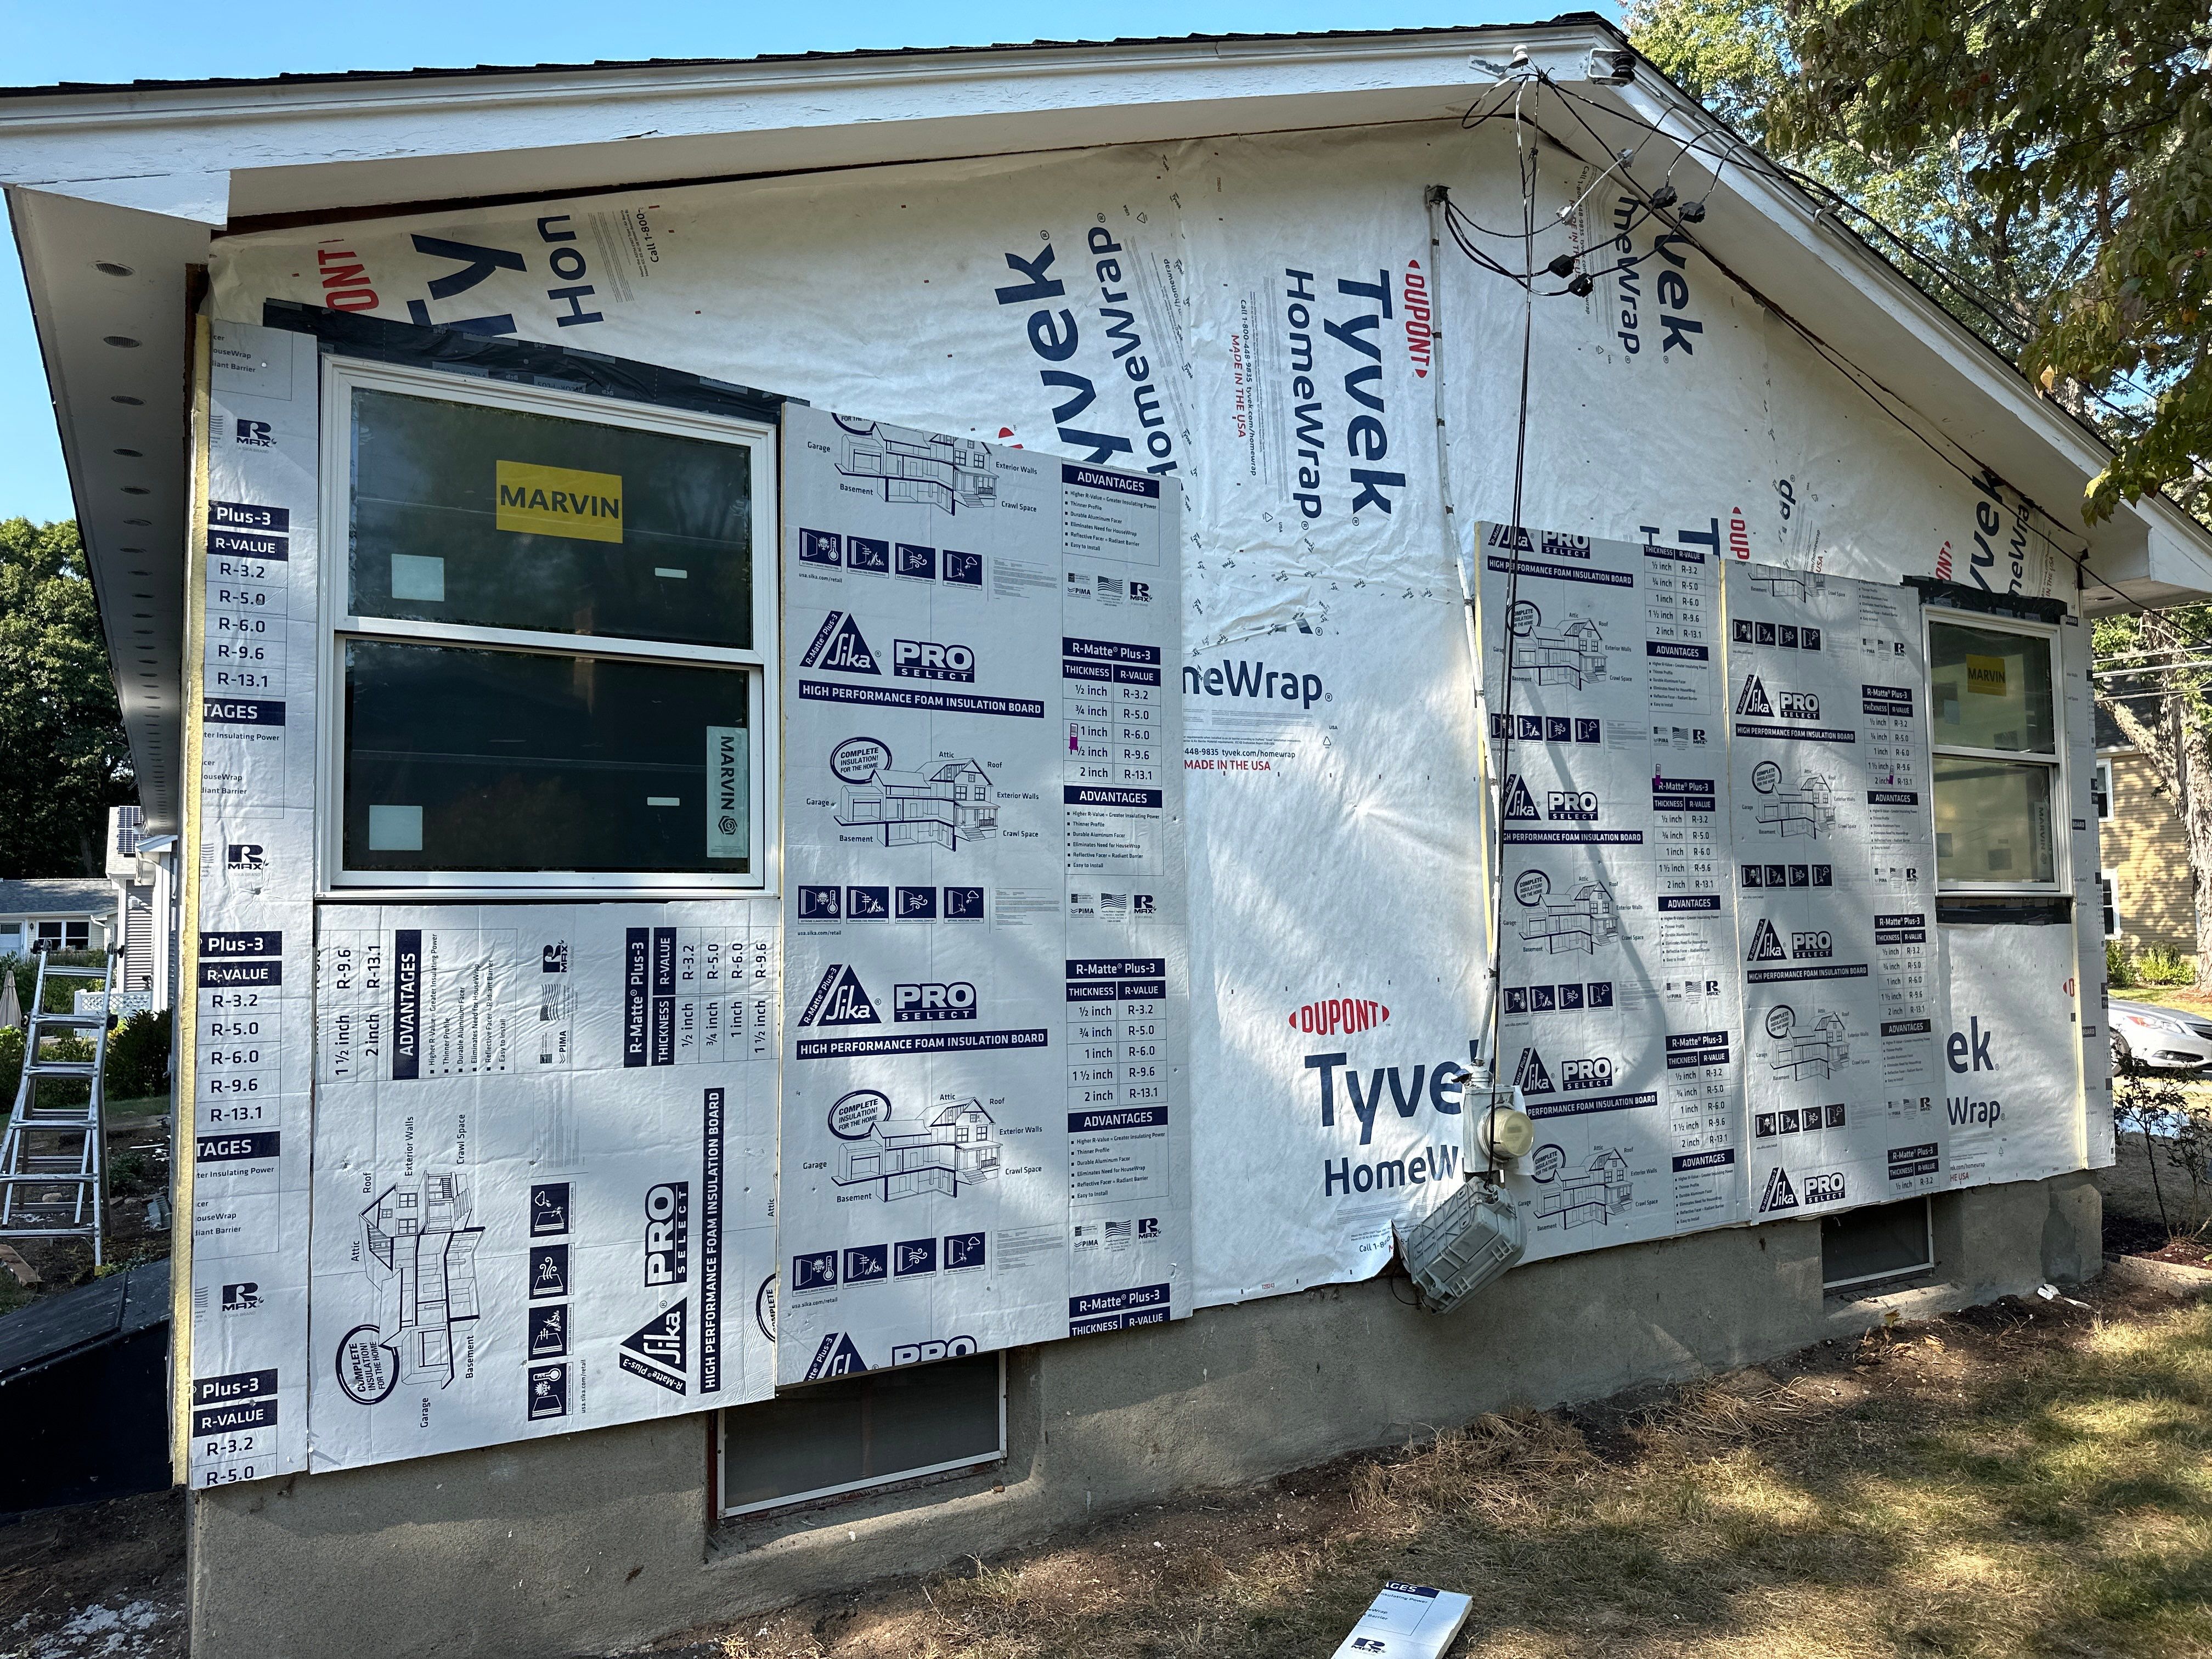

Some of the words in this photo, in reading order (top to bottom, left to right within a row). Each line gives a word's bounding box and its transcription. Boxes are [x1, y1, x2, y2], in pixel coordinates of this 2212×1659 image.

[636, 207, 652, 241] 1-800-
[647, 242, 659, 263] Call
[1404, 273, 1431, 371] DUPONT
[1231, 335, 1242, 370] MADE
[1242, 318, 1252, 382] 1-800-448-9835
[1235, 373, 1243, 385] IN
[1236, 388, 1244, 411] THE
[1237, 415, 1246, 438] USA
[1246, 387, 1256, 476] tyvek.com/homewrap
[808, 442, 831, 453] Garage
[996, 462, 1018, 473] Exterior
[1021, 465, 1037, 475] Walls
[840, 484, 873, 495] Basement
[1077, 472, 1144, 492] ADVANTAGES
[500, 484, 619, 520] MARVIN
[1001, 501, 1017, 510] Crawl
[1020, 504, 1037, 513] Space
[217, 506, 271, 527] Plus-3
[215, 537, 275, 554] R-VALUE
[220, 562, 264, 579] R-3.2
[220, 589, 265, 605] R-5.0
[219, 617, 266, 633] R-6.0
[218, 644, 264, 660] R-9.6
[896, 642, 973, 669] PRO
[1121, 648, 1150, 660] Plus-3
[217, 672, 268, 688] R-13.1
[901, 669, 967, 681] SELECT
[1065, 665, 1109, 677] THICKNESS
[1120, 670, 1153, 681] R-VALUE
[1968, 667, 2005, 683] MARVIN
[803, 685, 829, 697] HIGH
[832, 688, 911, 703] PERFORMANCE
[915, 694, 943, 706] FOAM
[946, 697, 1005, 710] INSULATION
[1008, 702, 1041, 713] BOARD
[1892, 691, 1906, 699] Plus-3
[1737, 727, 1750, 735] HIGH
[1752, 727, 1790, 736] PERFORMANCE
[1791, 729, 1805, 737] FOAM
[1806, 730, 1836, 739] INSULATION
[1222, 748, 1295, 759] tyvek.com/homewrap
[720, 736, 736, 810] MARVIN
[1184, 760, 1215, 770] MADE
[1217, 760, 1227, 770] IN
[1229, 760, 1249, 770] THE
[1251, 760, 1271, 771] USA
[1689, 783, 1708, 792] Plus-3
[1549, 793, 1596, 811] PRO
[1673, 881, 1685, 889] inch
[1668, 899, 1711, 909] ADVANTAGES
[208, 937, 263, 951] Plus-3
[337, 949, 351, 989] R-9.6
[367, 945, 381, 988] R-13.1
[631, 942, 644, 985] Plus-3
[660, 937, 670, 985] R-VALUE
[682, 945, 695, 980] R-3.2
[732, 943, 743, 979] R-6.0
[207, 968, 268, 981] R-VALUE
[399, 952, 415, 1057] ADVANTAGES
[731, 1001, 742, 1028] inch
[681, 1002, 693, 1030] inch
[1301, 998, 1378, 1035] DUPONT
[335, 1015, 349, 1045] inch
[366, 1014, 380, 1045] inch
[658, 1001, 669, 1063] THICKNESS
[681, 1034, 693, 1047] ½
[365, 1048, 376, 1056] 2
[1085, 1092, 1090, 1102] 2
[1093, 1090, 1113, 1101] inch
[1130, 1087, 1158, 1098] R-13.1
[1305, 1040, 1479, 1145] Tyve
[210, 1106, 262, 1122] R-13.1
[709, 1093, 720, 1133] BOARD
[405, 1116, 414, 1138] Walls
[457, 1114, 467, 1138] Space
[708, 1136, 719, 1214] INSULATION
[648, 1186, 675, 1285] PRO
[678, 1190, 687, 1273] SELECT
[707, 1216, 718, 1254] FOAM
[351, 1240, 359, 1261] Attic
[1359, 1243, 1372, 1252] Call
[706, 1257, 718, 1351] PERFORMANCE
[370, 1341, 380, 1361] HOME
[349, 1344, 365, 1392] COMPLETE
[359, 1342, 376, 1390] INSULATION!
[374, 1362, 382, 1375] THE
[623, 1359, 646, 1378] Plus-3
[705, 1353, 716, 1388] HIGH
[377, 1376, 385, 1389] FOR
[420, 1397, 430, 1427] Garage
